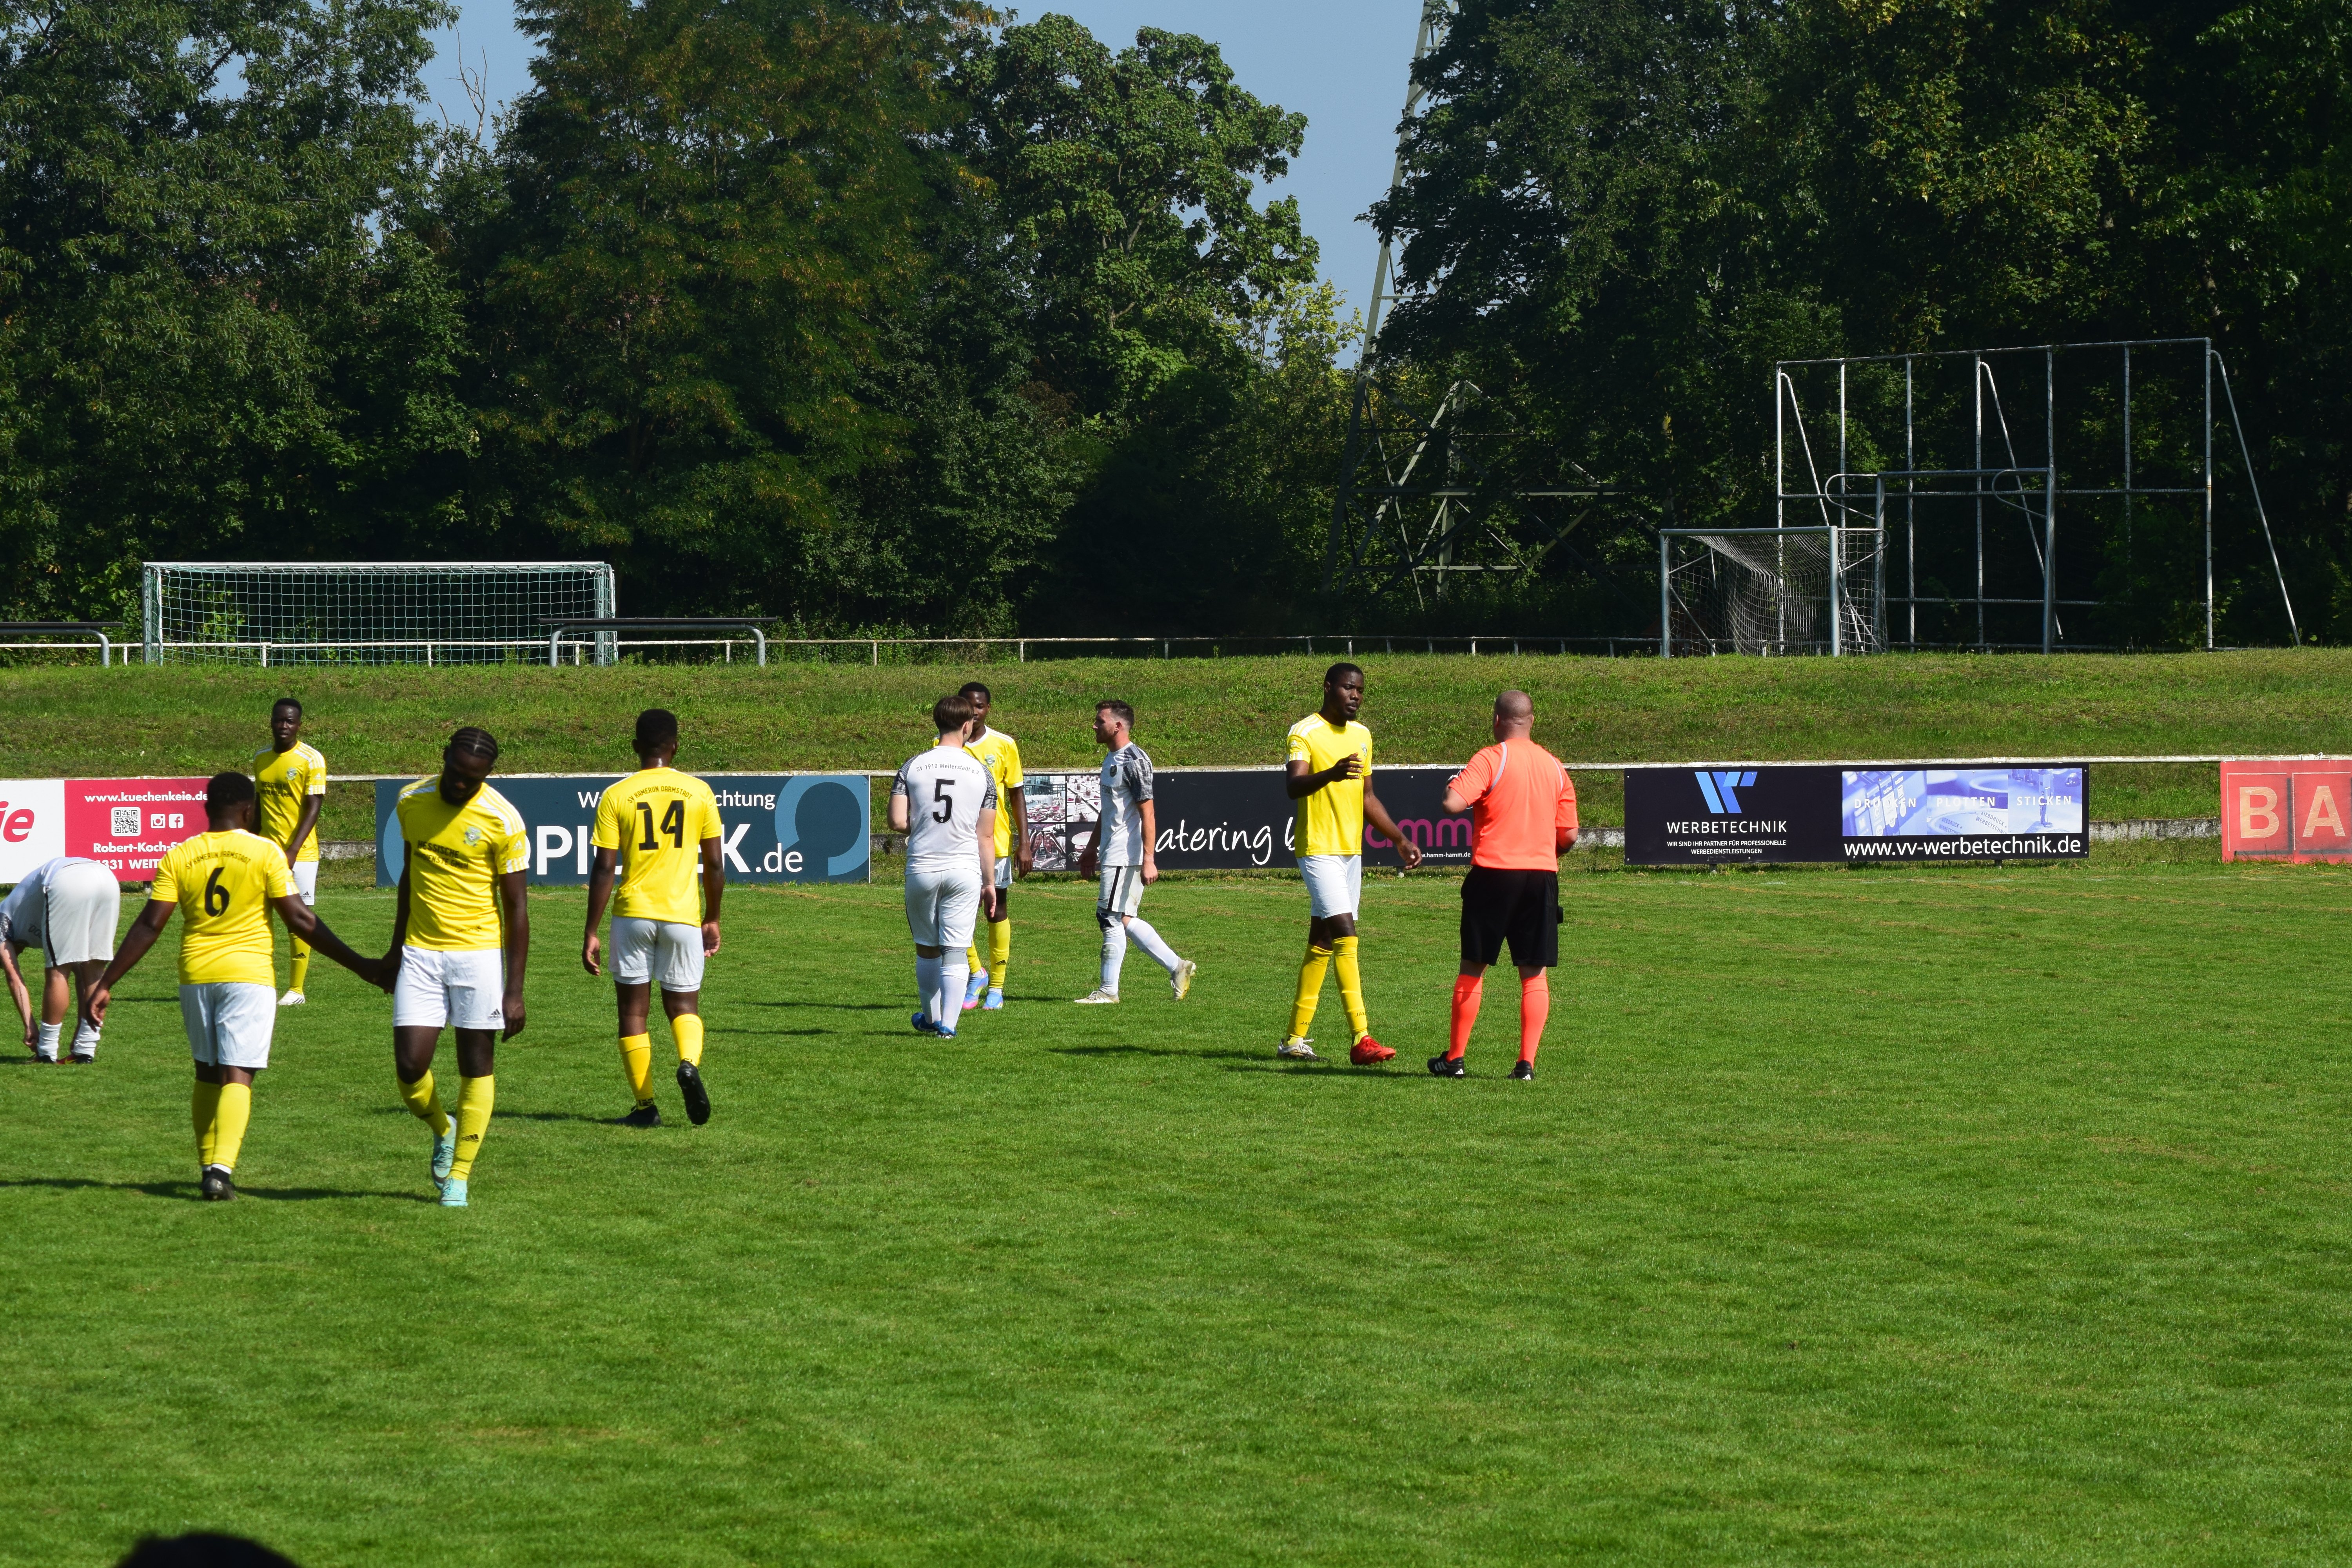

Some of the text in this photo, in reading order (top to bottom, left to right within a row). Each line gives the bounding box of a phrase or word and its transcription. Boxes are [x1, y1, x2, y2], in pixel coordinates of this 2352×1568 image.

[939, 763, 970, 771] Weiterstadt
[84, 791, 208, 802] www.kuechenkeie.de
[634, 786, 659, 798] KAMERUN
[661, 786, 693, 799] DARMSTADT
[932, 778, 956, 824] 5
[1937, 797, 1995, 807] PLOTTEN
[2017, 796, 2071, 806] STICKEN
[637, 800, 684, 851] 14
[1667, 820, 1787, 833] WERBETECHNIK
[1155, 819, 1272, 865] atering
[1844, 835, 2081, 856] www.vv-werbetechnik.de
[205, 867, 230, 917] 6
